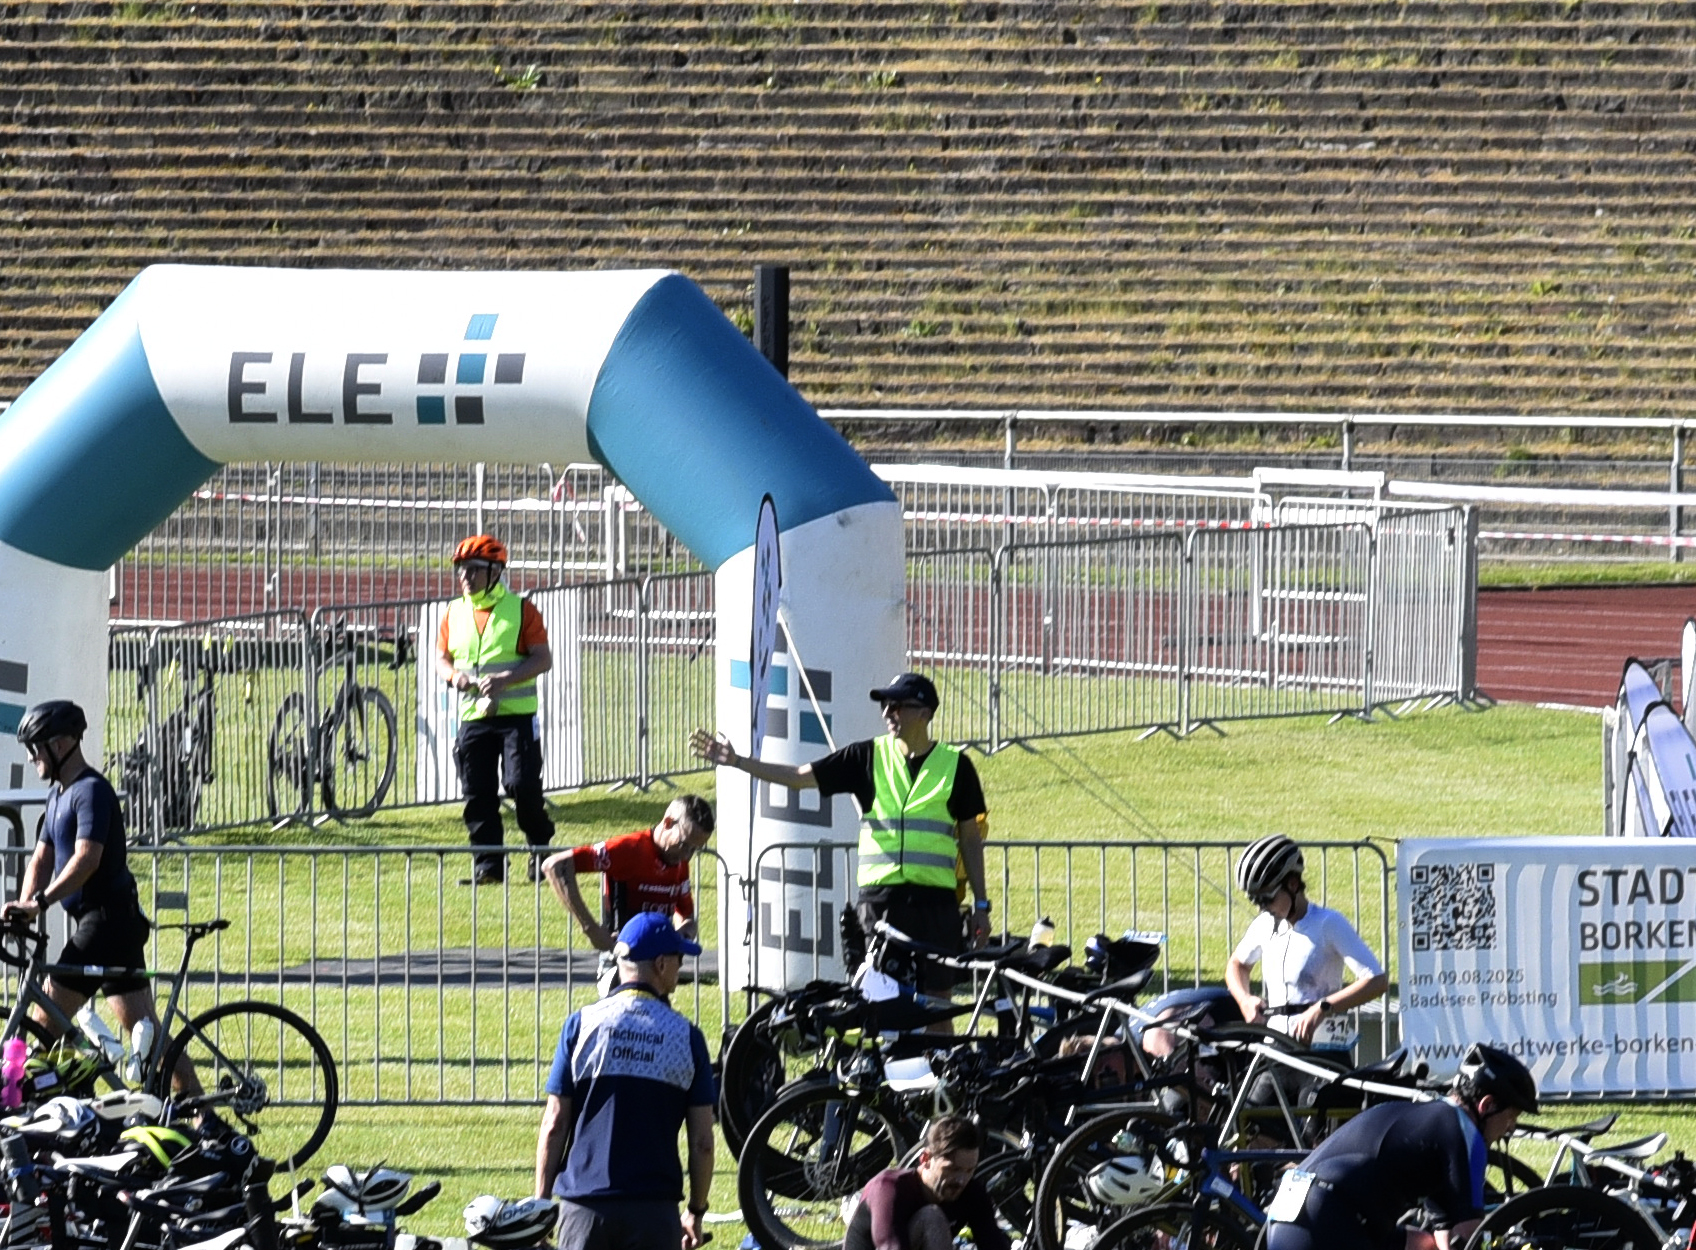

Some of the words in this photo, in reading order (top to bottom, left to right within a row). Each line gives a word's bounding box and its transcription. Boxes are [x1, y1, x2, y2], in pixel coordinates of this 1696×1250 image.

[228, 352, 393, 424] ELE
[1409, 973, 1432, 985] am
[1438, 968, 1525, 984] 09.08.2025
[1409, 991, 1476, 1009] Badesee
[1481, 989, 1559, 1009] Pröbsting
[609, 1027, 665, 1044] Technical
[612, 1045, 655, 1063] Official
